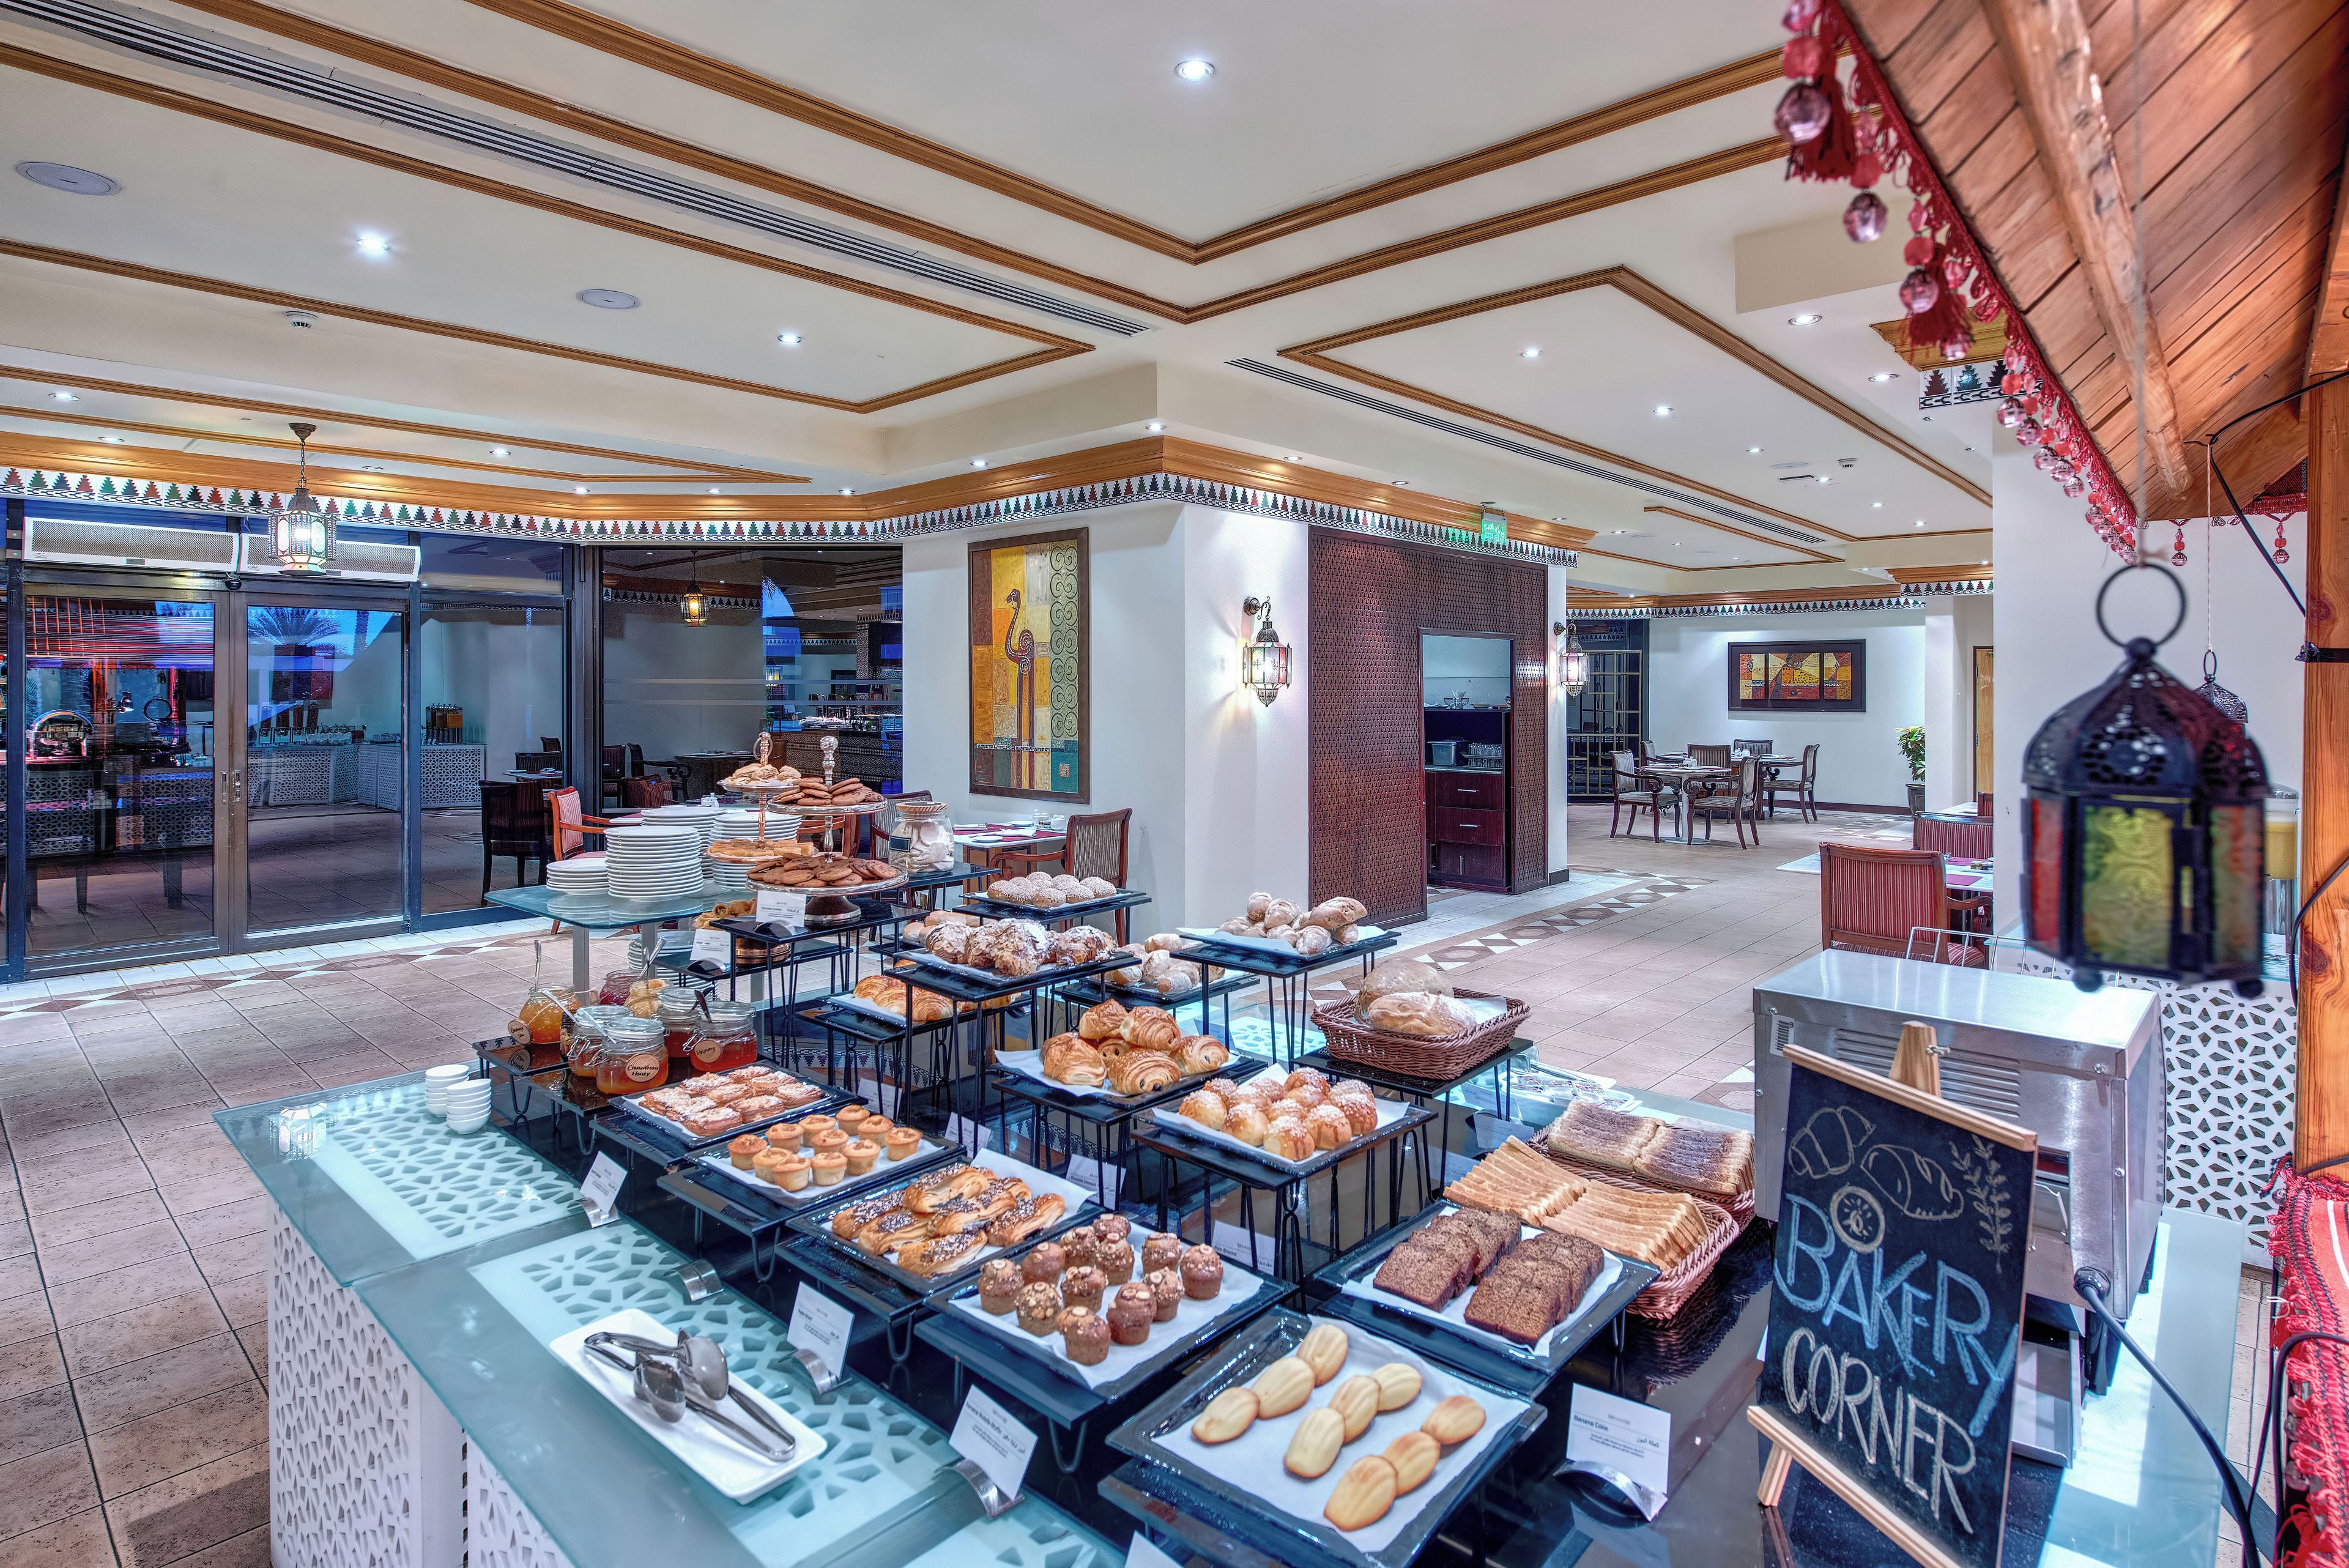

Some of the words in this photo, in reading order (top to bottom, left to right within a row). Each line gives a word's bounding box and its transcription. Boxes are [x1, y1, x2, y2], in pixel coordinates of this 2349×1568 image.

[1773, 1192, 2020, 1438] BAKERY
[1573, 1414, 1594, 1427] Banana
[1595, 1422, 1609, 1431] Cake
[1782, 1326, 1977, 1534] CORNER
